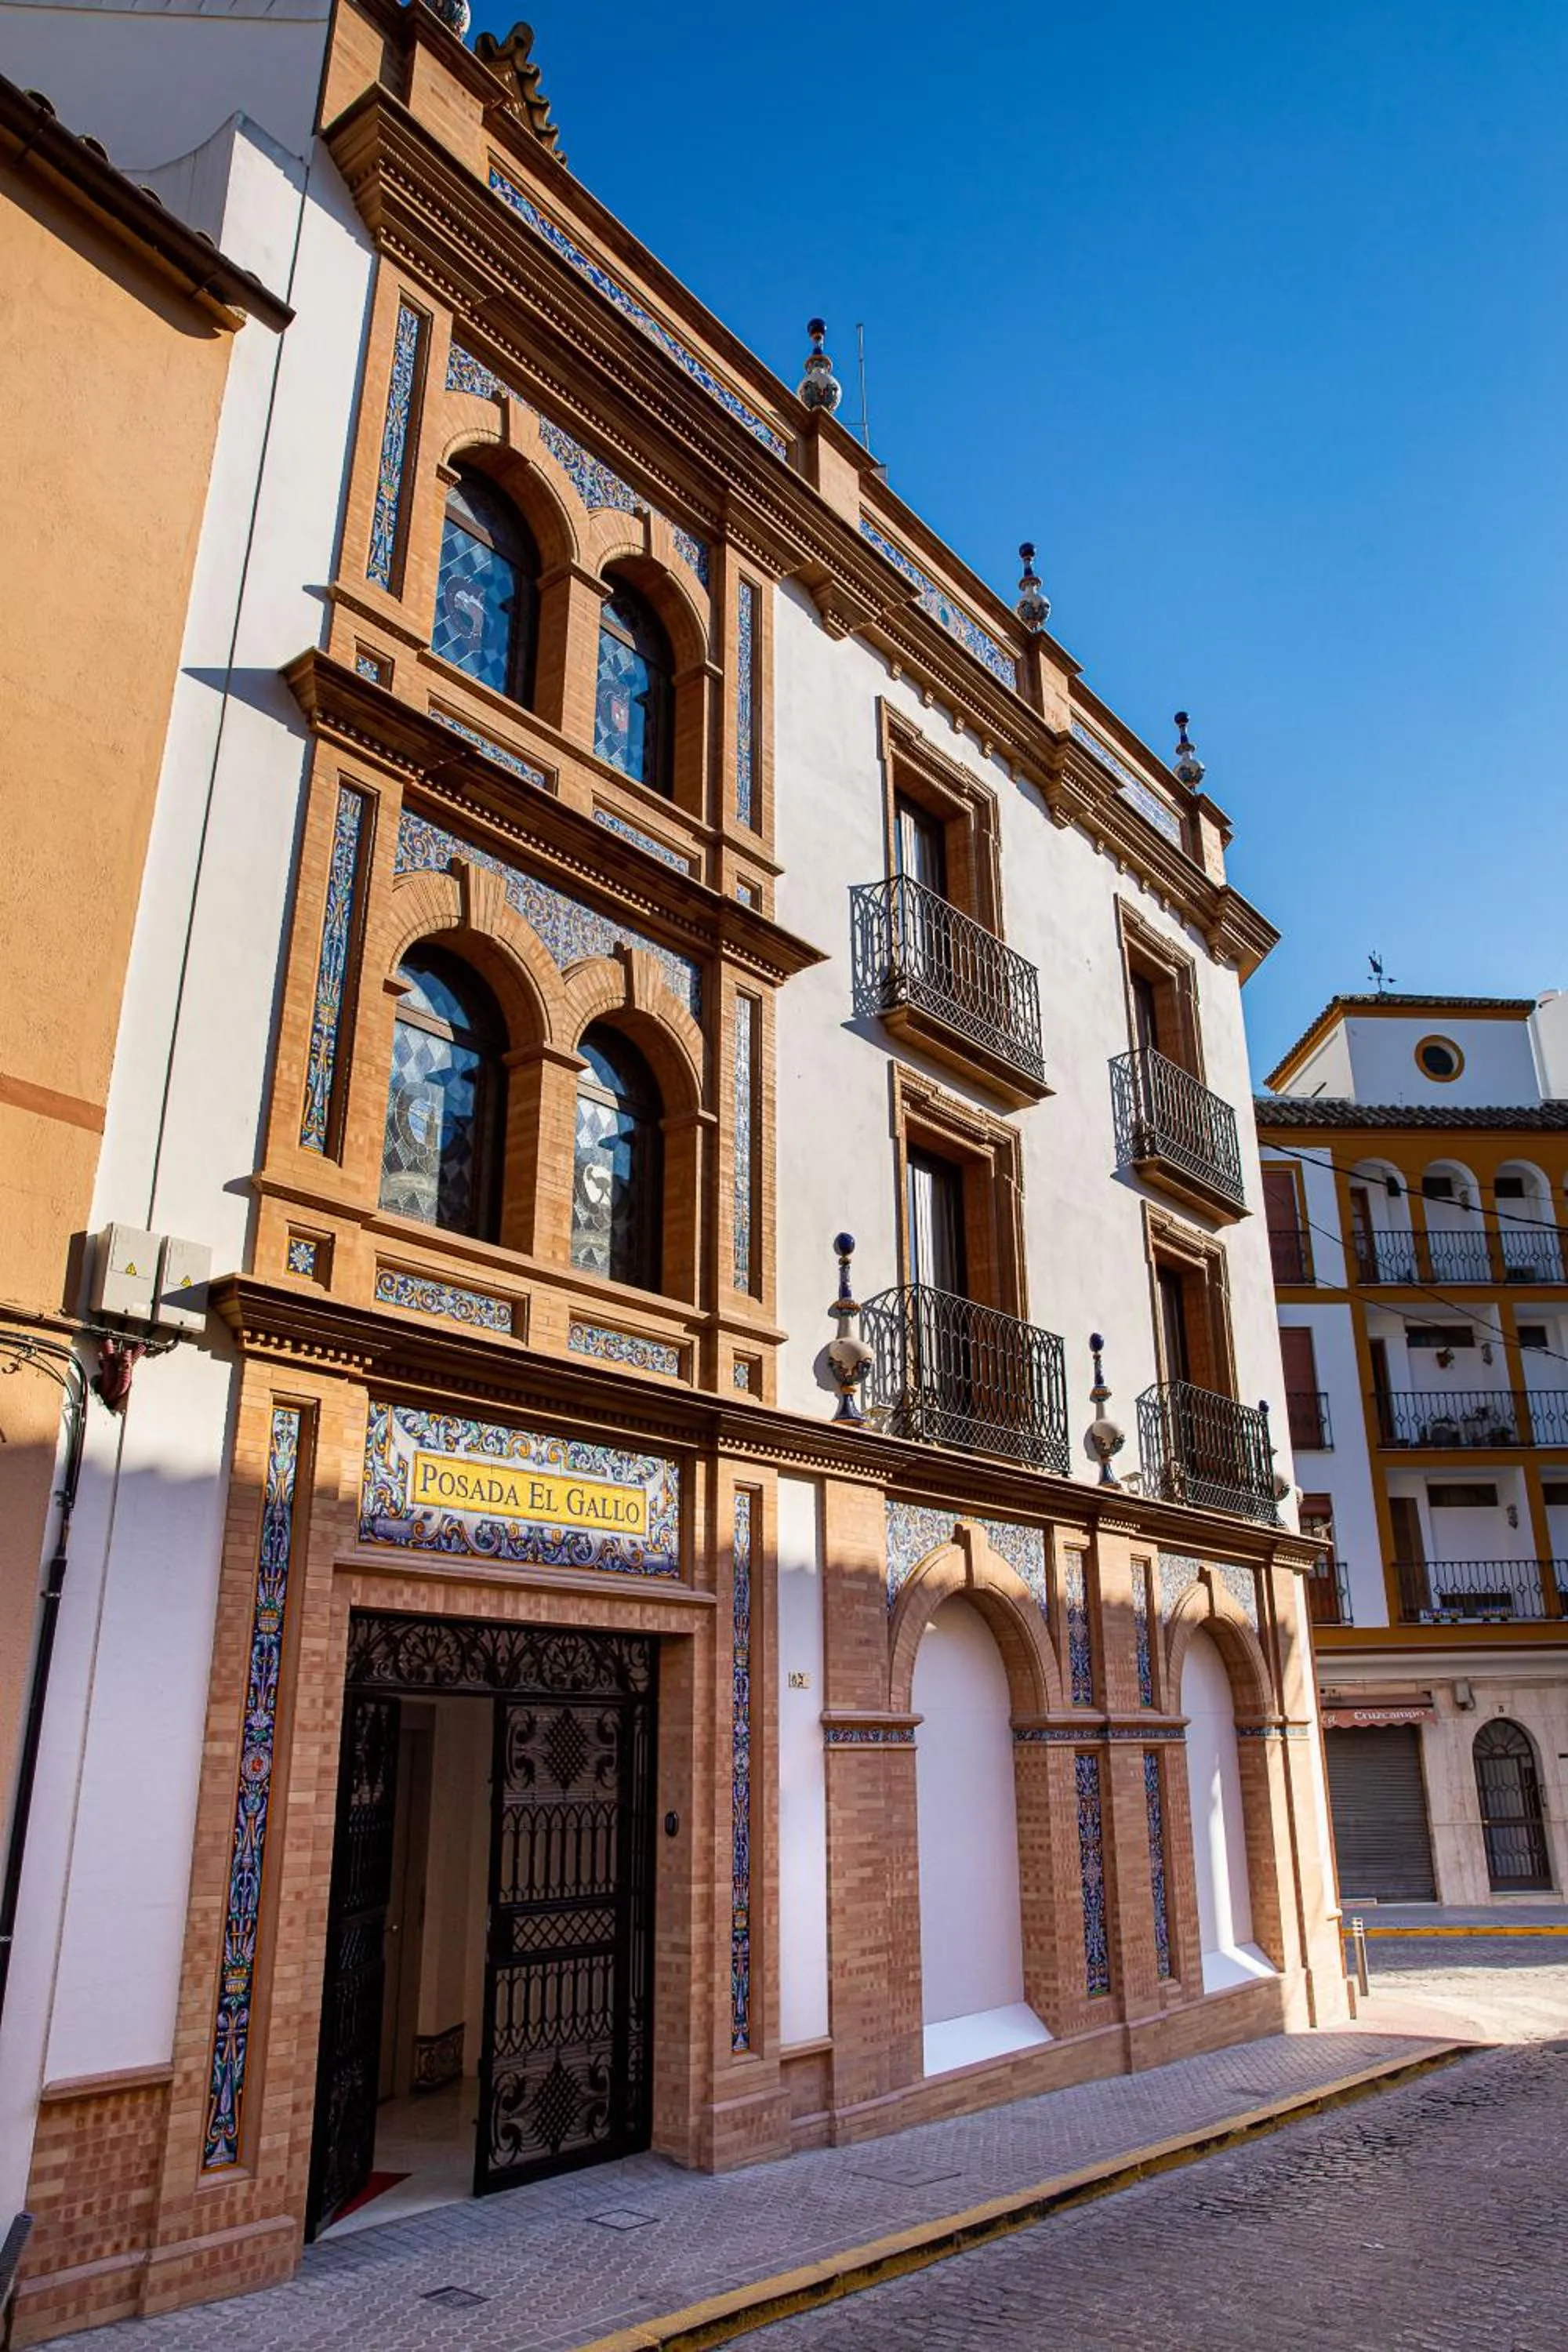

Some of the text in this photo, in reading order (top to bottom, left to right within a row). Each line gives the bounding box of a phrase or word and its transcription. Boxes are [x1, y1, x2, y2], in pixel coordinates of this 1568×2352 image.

[419, 1463, 640, 1524] POSADA EL GALLO
[1354, 1710, 1425, 1720] Cruzcampo
